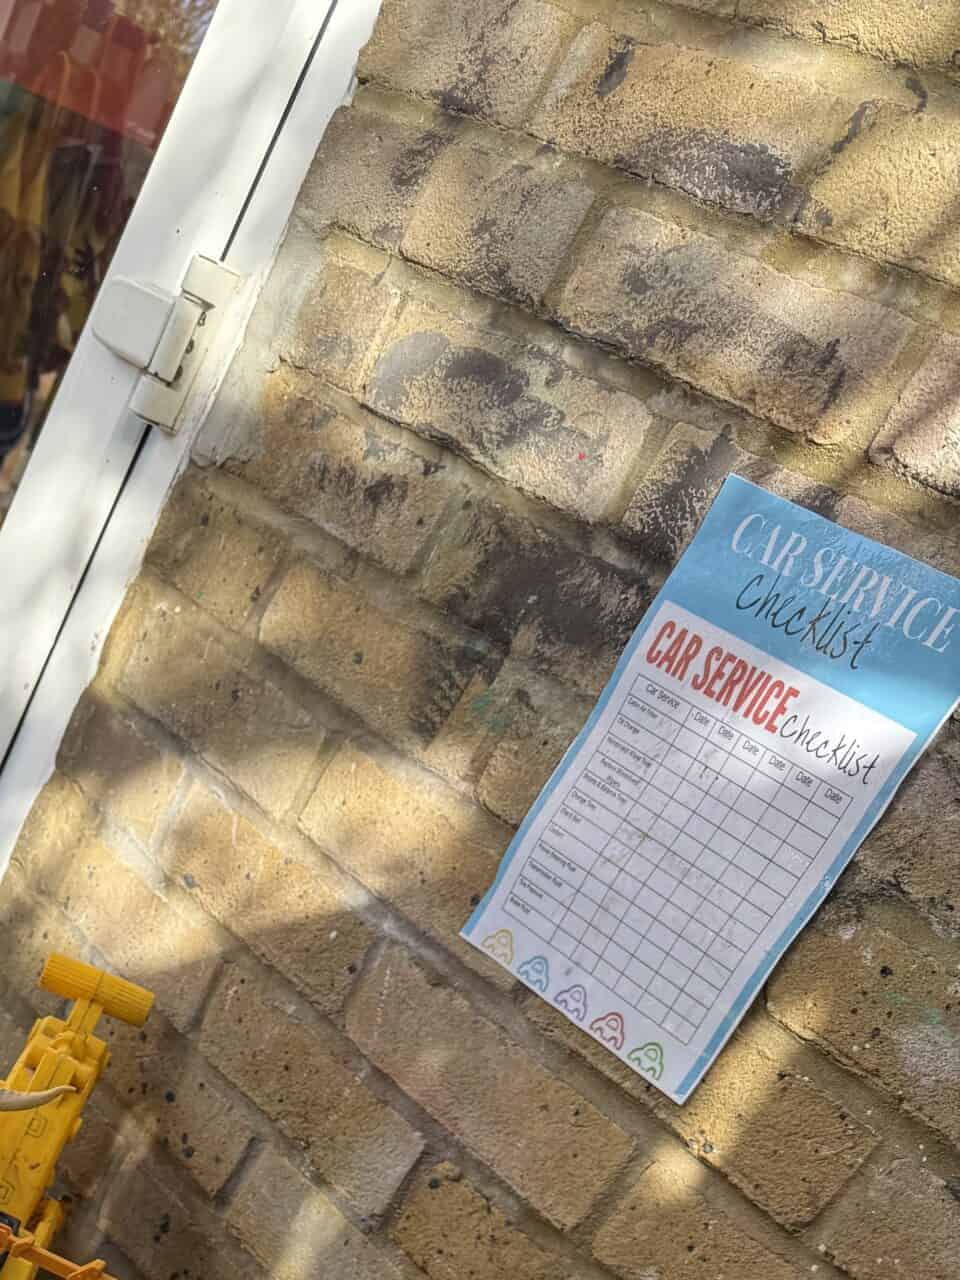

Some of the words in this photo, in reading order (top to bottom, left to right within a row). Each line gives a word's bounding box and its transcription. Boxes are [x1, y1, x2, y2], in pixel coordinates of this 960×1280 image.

[731, 512, 808, 576] CAR
[800, 547, 960, 653] SERVICE
[645, 620, 704, 682] CAR
[691, 645, 801, 734] SERVICE
[693, 710, 711, 727] Date
[741, 739, 760, 756] Date
[768, 755, 787, 773] Date
[795, 770, 814, 788] Date
[824, 787, 842, 805] Date
